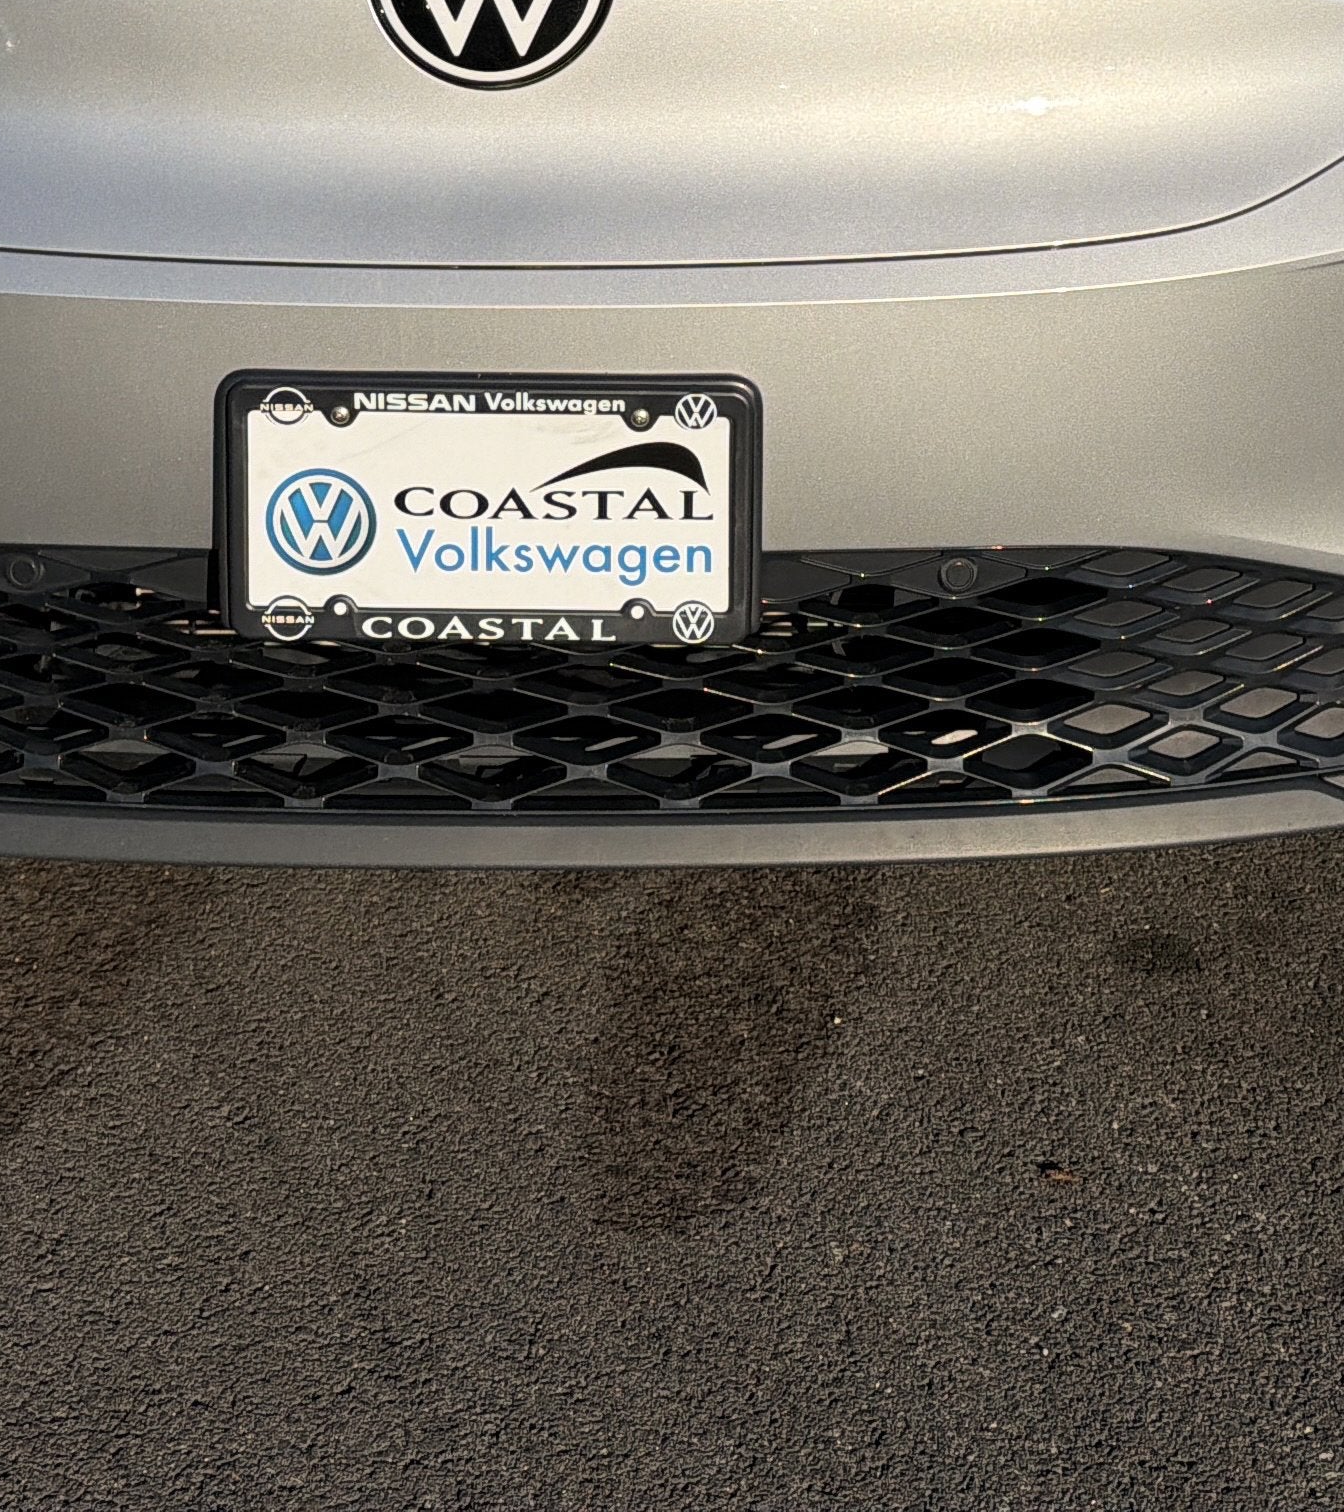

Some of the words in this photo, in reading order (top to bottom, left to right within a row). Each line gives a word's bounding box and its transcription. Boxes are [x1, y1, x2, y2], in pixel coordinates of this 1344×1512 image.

[259, 402, 314, 413] NISSAN
[353, 392, 476, 412] NISSAN
[484, 392, 626, 416] Volkswagen
[677, 394, 717, 428] VW
[393, 487, 714, 520] COASTAL
[276, 476, 366, 568] VW
[396, 525, 713, 586] Volkswagen
[261, 615, 315, 625] NISSAN
[361, 615, 617, 642] COASTAL
